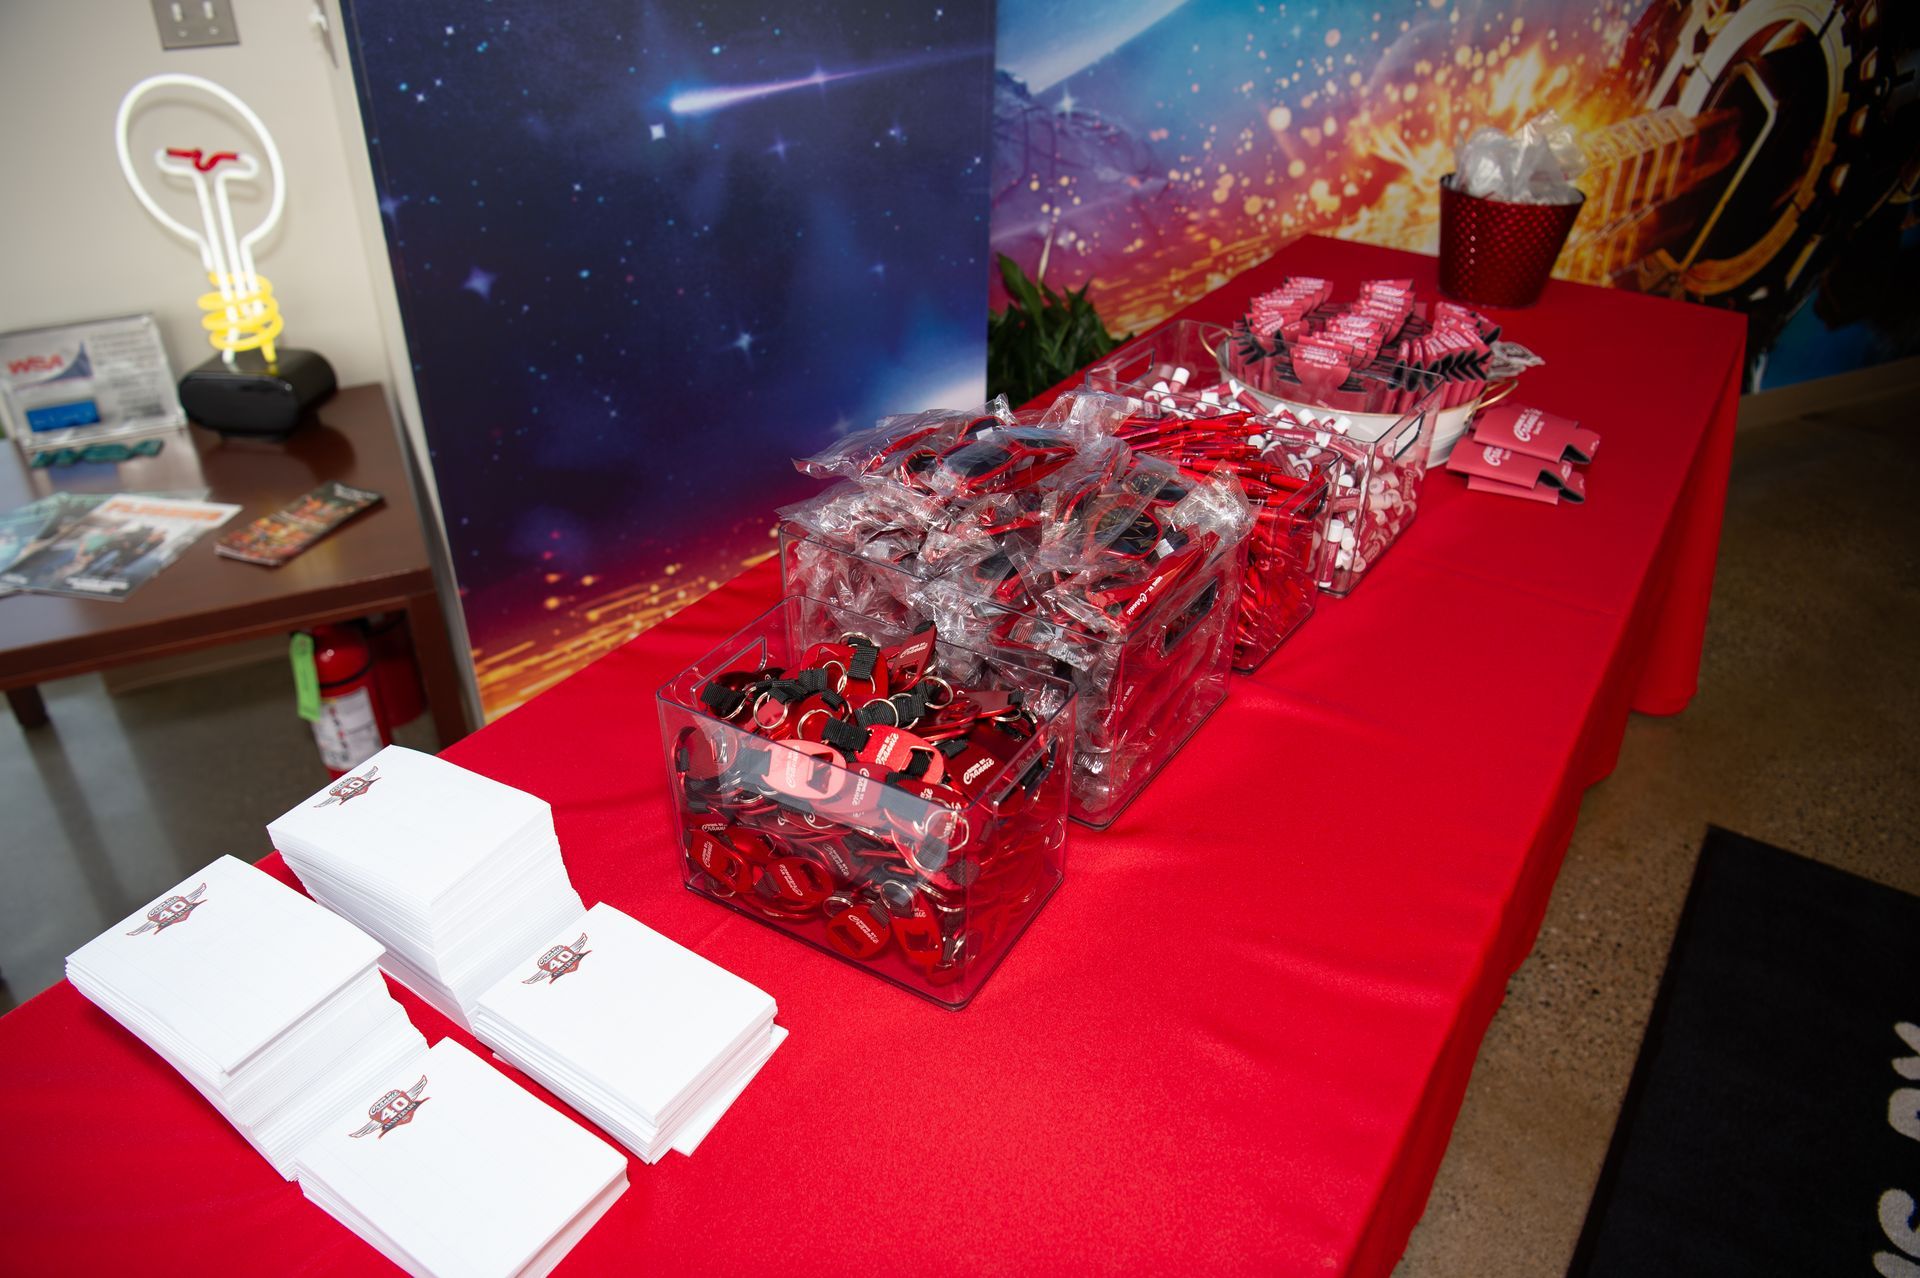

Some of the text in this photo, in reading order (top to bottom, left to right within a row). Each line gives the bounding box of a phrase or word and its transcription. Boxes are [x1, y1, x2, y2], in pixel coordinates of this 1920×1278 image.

[963, 758, 995, 785] Crannie
[341, 780, 364, 795] 40
[852, 768, 869, 806] Crannie
[779, 864, 804, 896] Crannie
[160, 901, 187, 920] 40
[848, 914, 880, 944] Crannie
[549, 950, 573, 970] 40
[381, 1096, 409, 1120] 40
